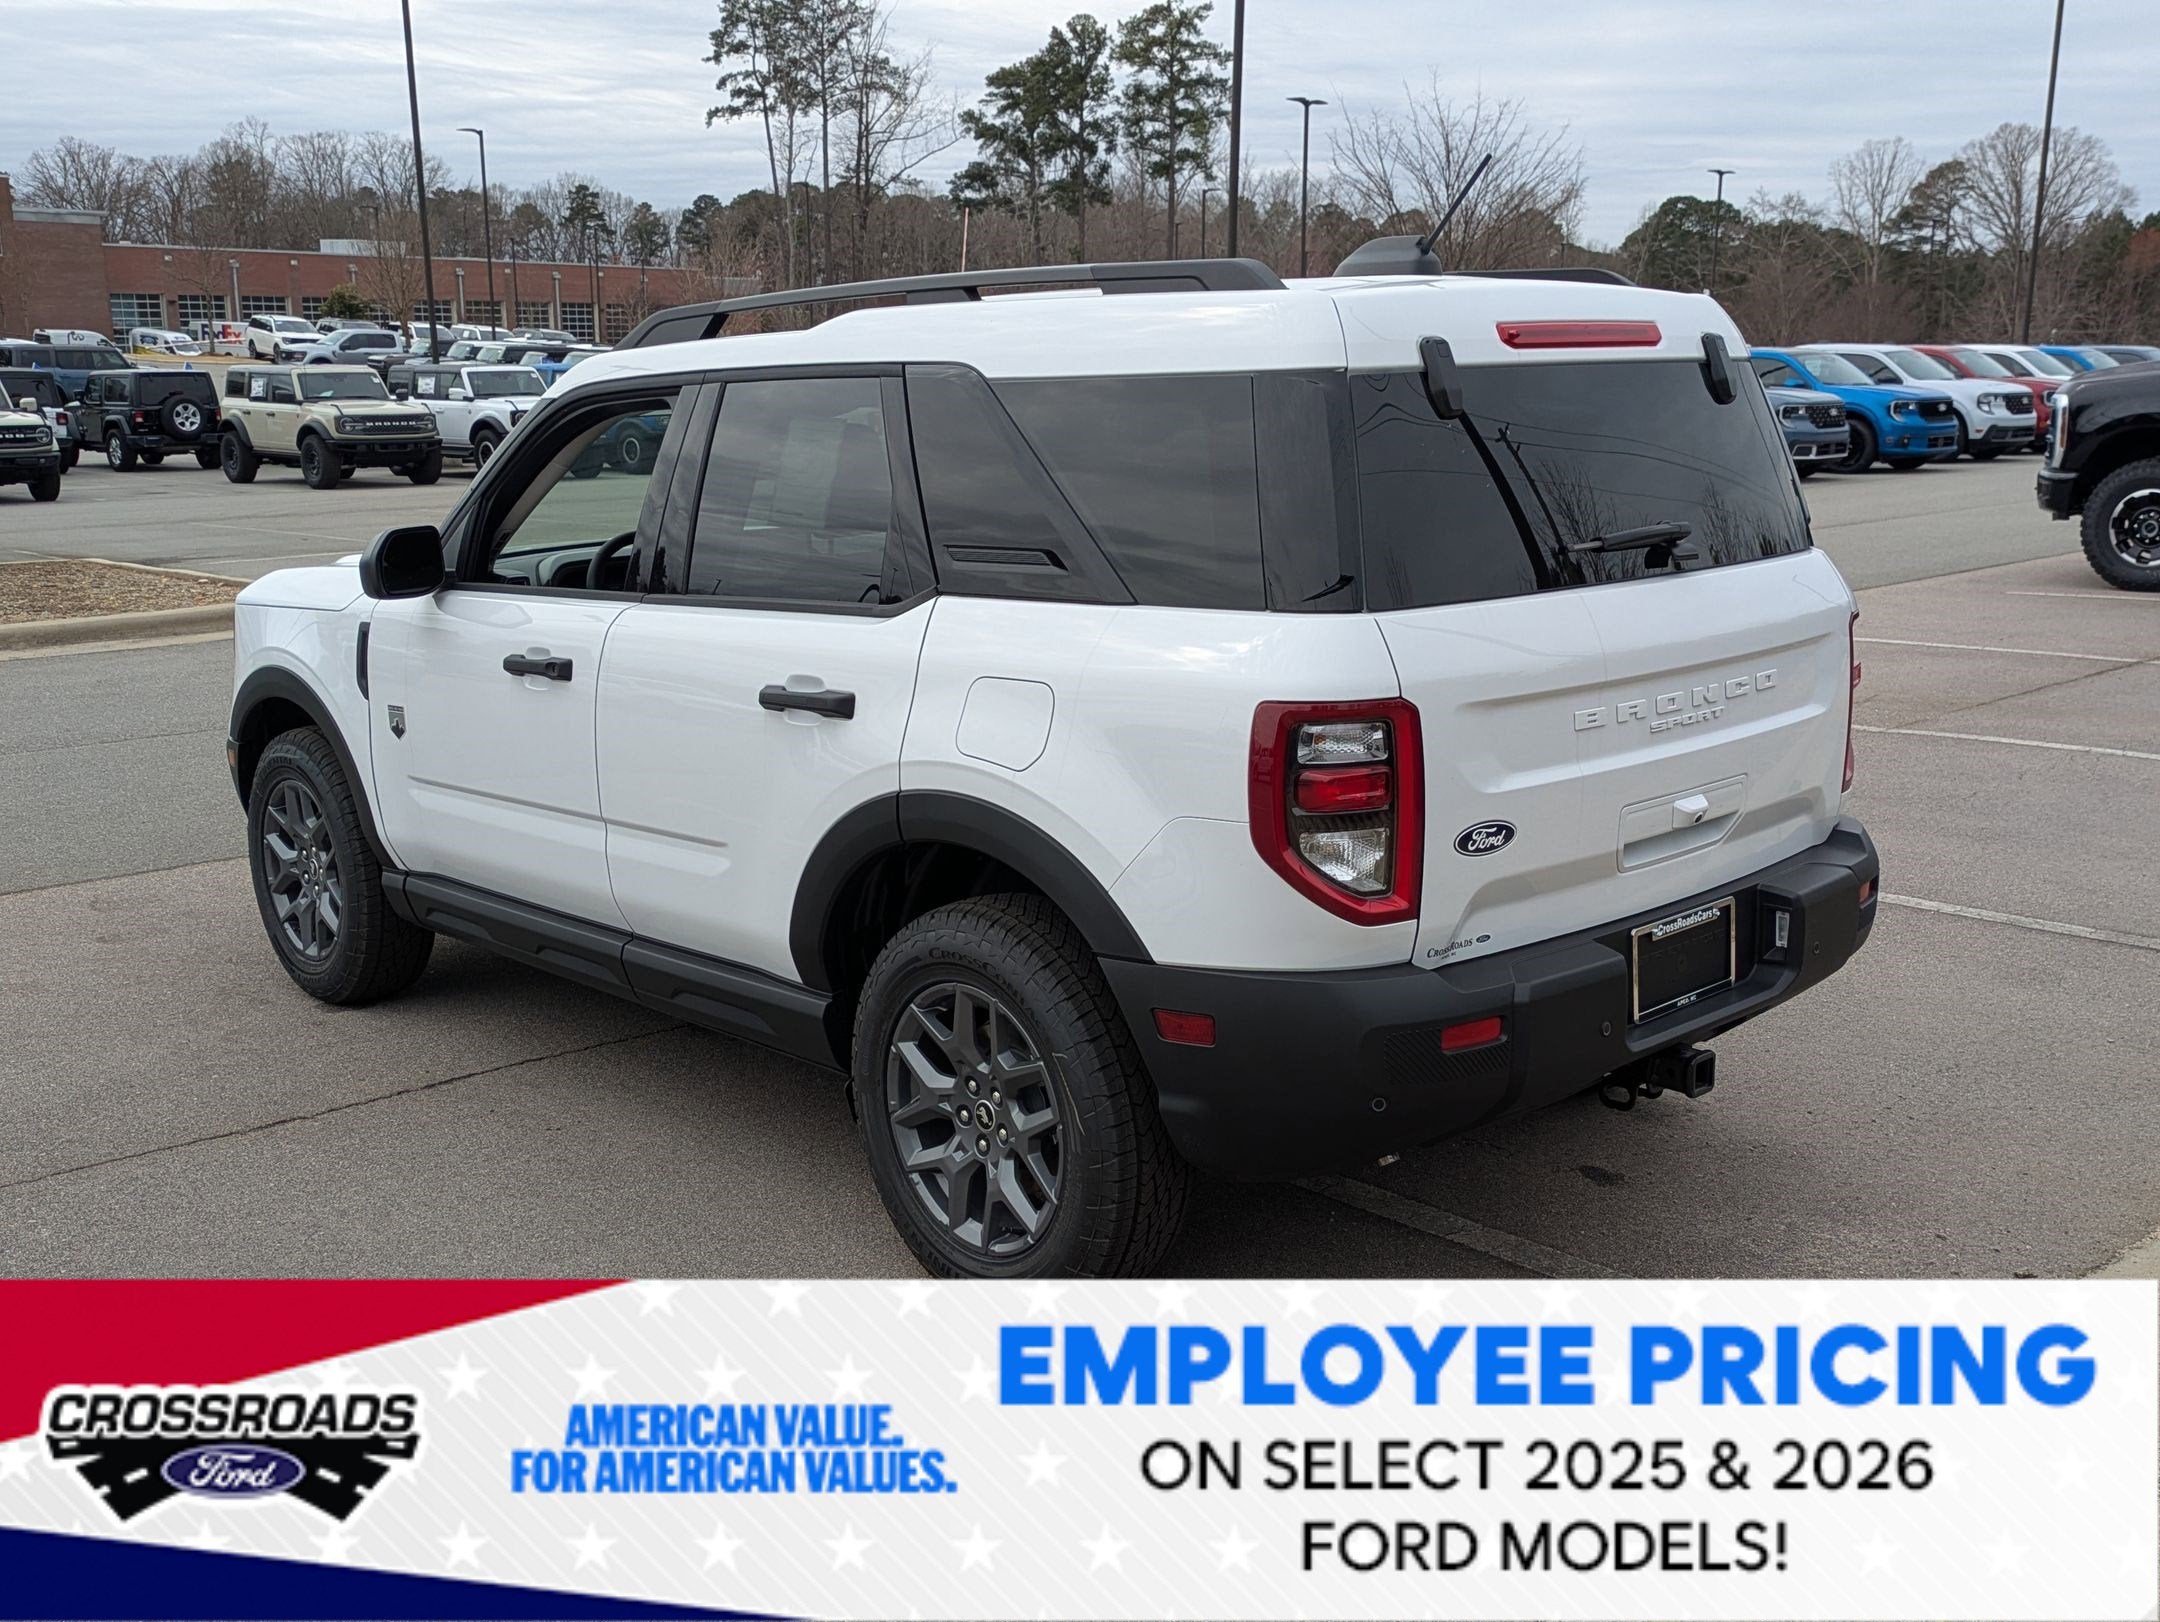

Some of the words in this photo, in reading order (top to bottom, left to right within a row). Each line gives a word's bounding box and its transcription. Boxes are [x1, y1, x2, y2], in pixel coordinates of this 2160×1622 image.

[1574, 668, 1778, 731] BRONCO
[1649, 706, 1725, 733] SPORT
[1468, 827, 1506, 851] Ford
